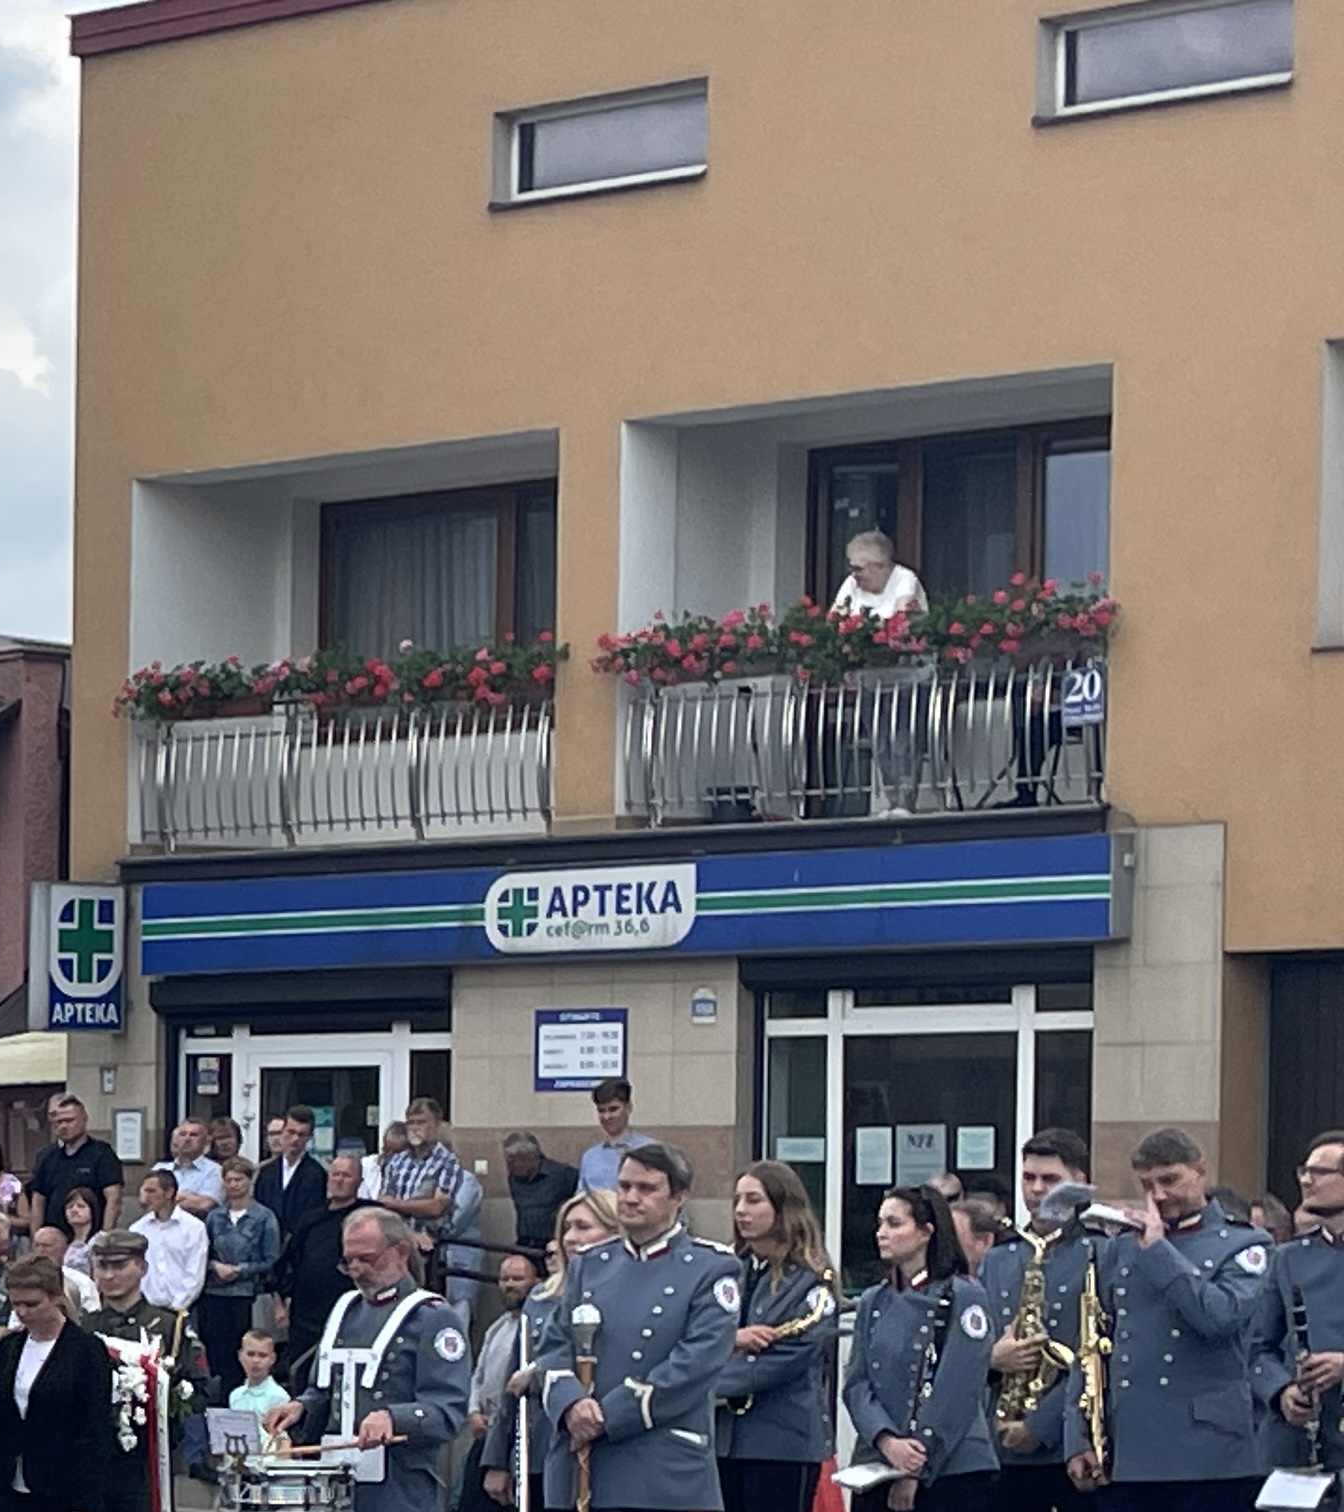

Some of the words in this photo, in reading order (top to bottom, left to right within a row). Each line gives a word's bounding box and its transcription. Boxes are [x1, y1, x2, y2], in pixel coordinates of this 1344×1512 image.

[1064, 669, 1101, 703] 20
[545, 880, 682, 918] APTEKA
[545, 920, 610, 939] cef@rm
[614, 917, 650, 937] 36,6
[52, 1002, 119, 1023] APTEKA
